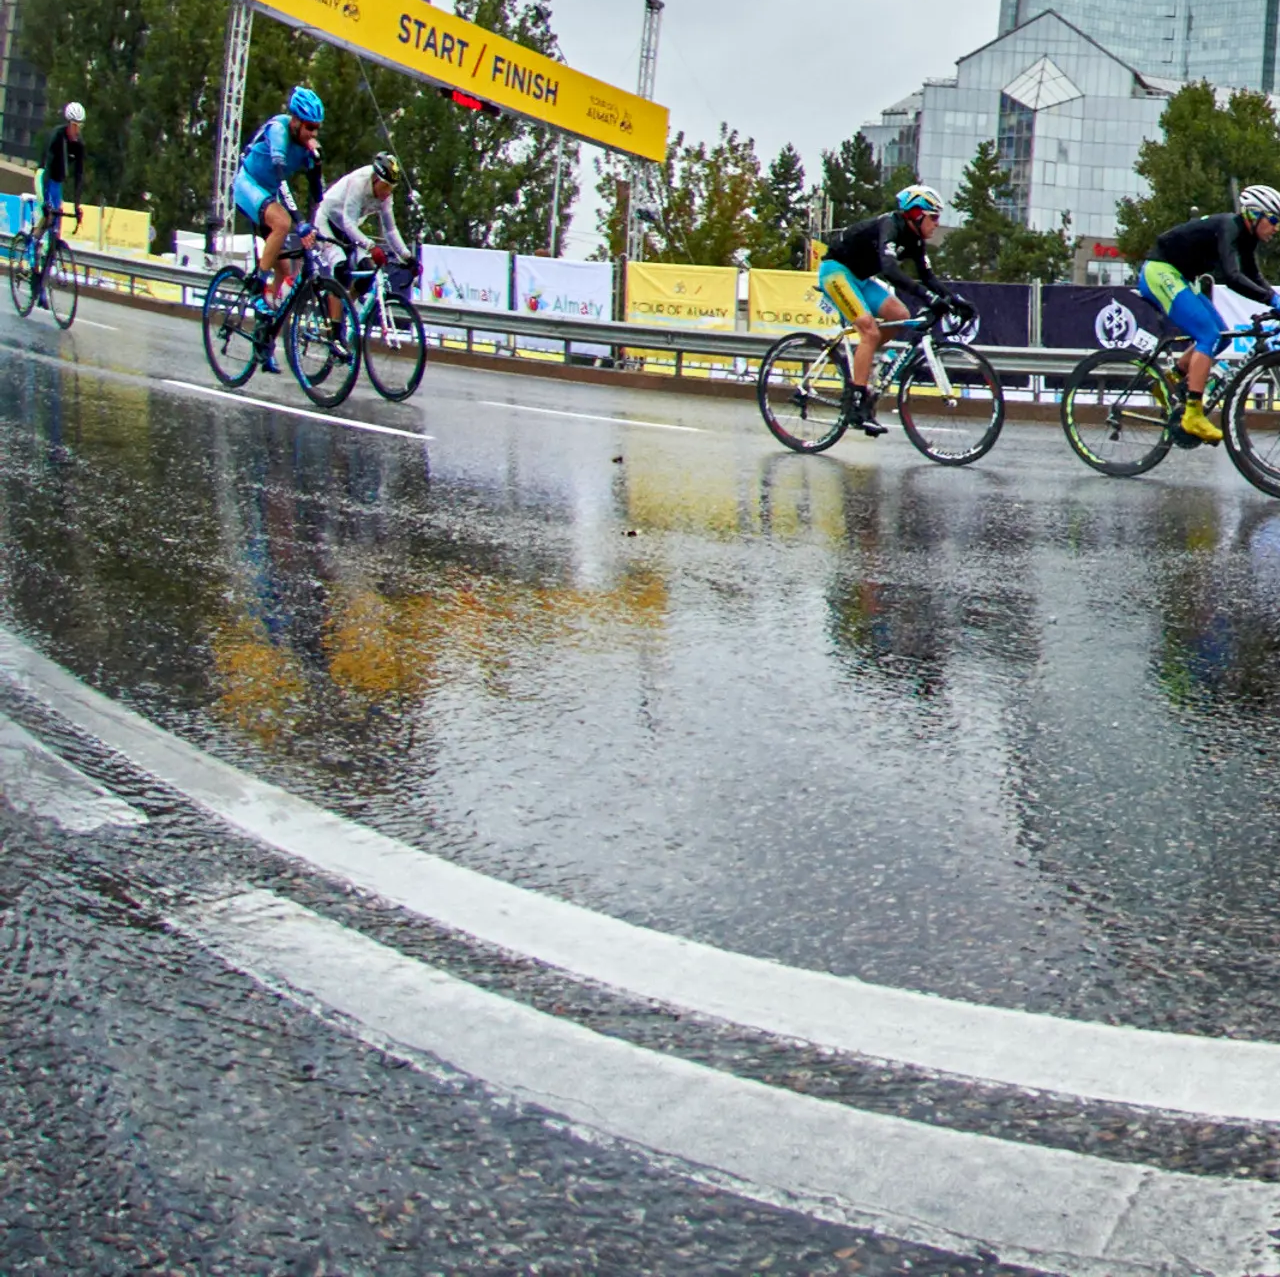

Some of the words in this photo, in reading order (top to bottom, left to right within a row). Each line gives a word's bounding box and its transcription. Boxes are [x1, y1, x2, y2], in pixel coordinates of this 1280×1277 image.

[397, 13, 470, 68] START
[491, 55, 560, 106] FINISH
[456, 283, 501, 307] Almaty
[552, 294, 603, 317] Almaty
[632, 301, 664, 315] TOUR
[667, 304, 681, 316] OF
[686, 306, 728, 319] ALMATY
[756, 310, 792, 324] TOUR
[795, 313, 812, 325] OF
